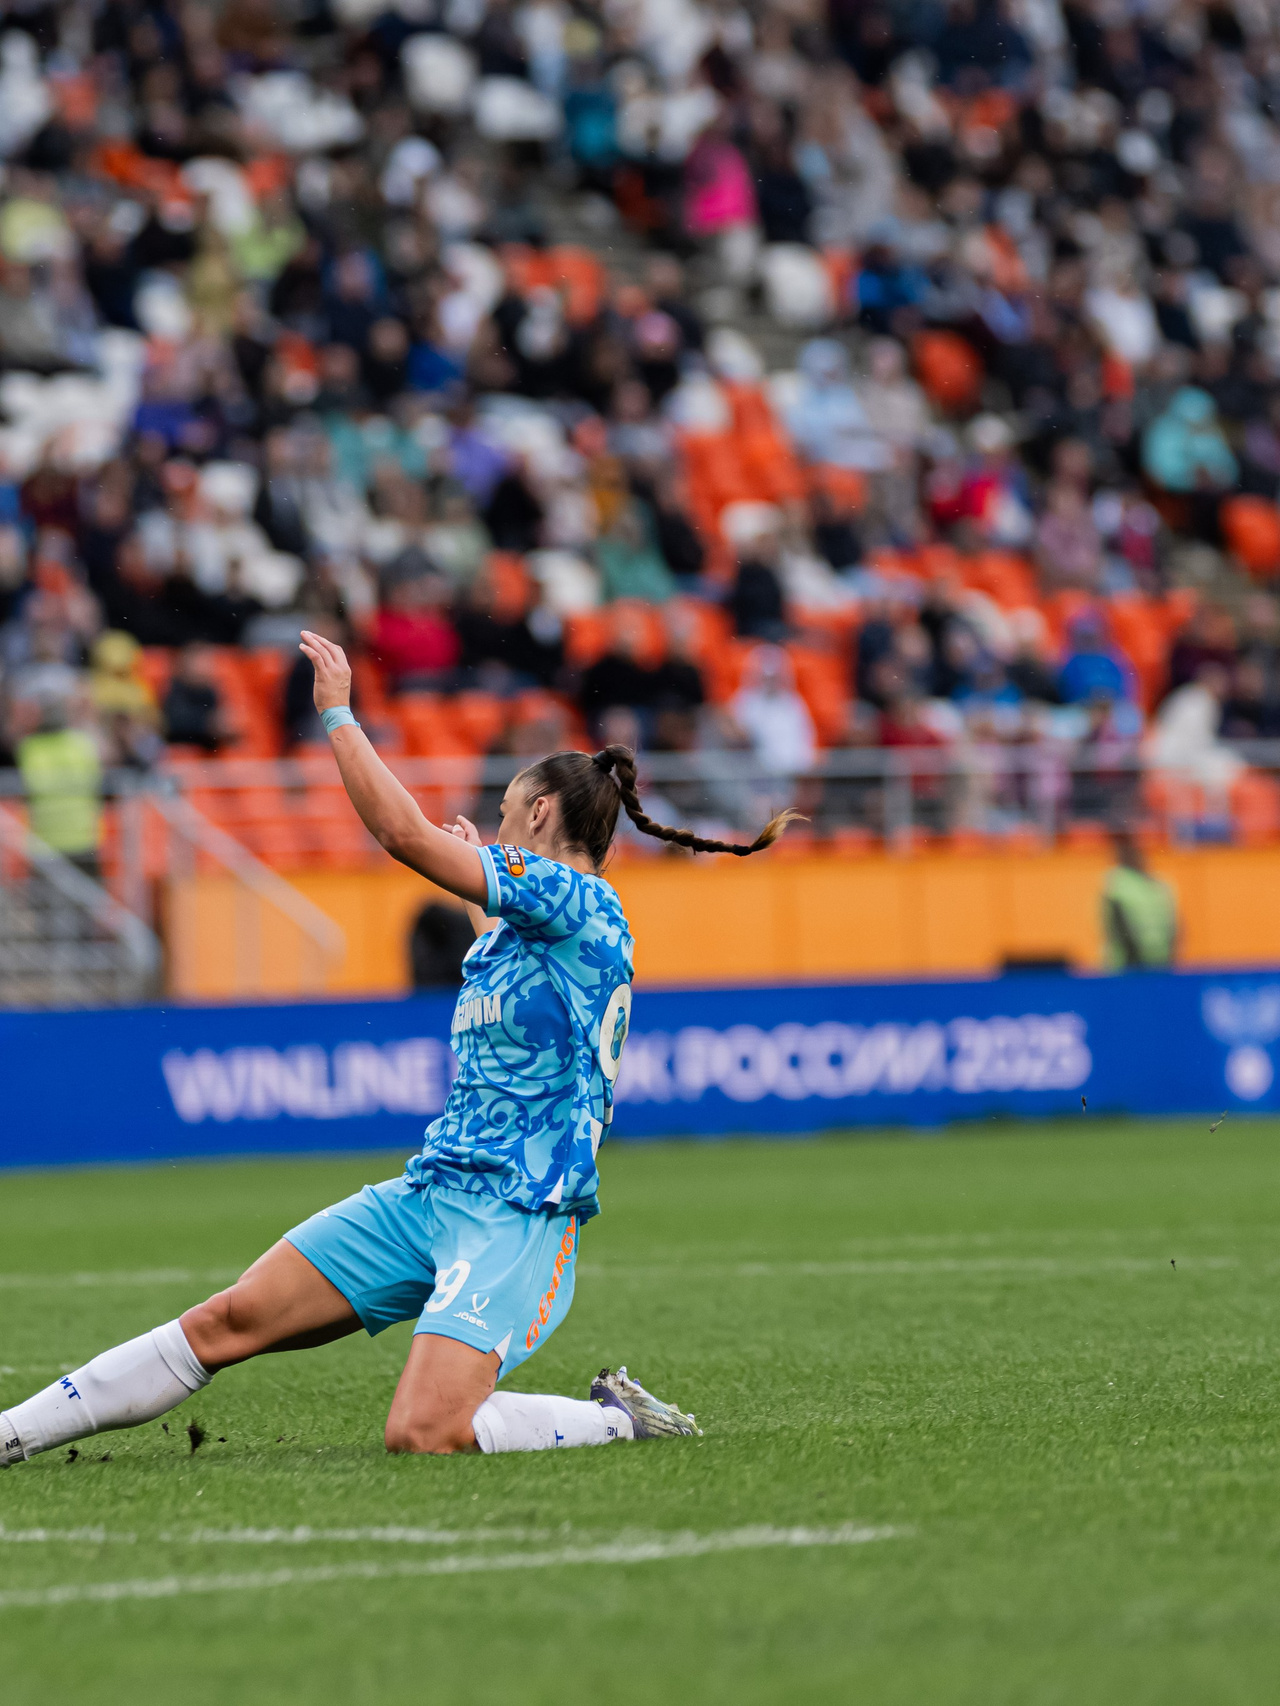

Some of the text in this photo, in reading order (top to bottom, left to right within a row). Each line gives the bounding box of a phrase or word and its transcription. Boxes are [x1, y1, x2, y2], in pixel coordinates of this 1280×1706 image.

[162, 1038, 452, 1122] WINLINE
[676, 1020, 948, 1102] РОССИИ
[948, 1013, 1092, 1093] 2025
[60, 1376, 81, 1400] ИТ
